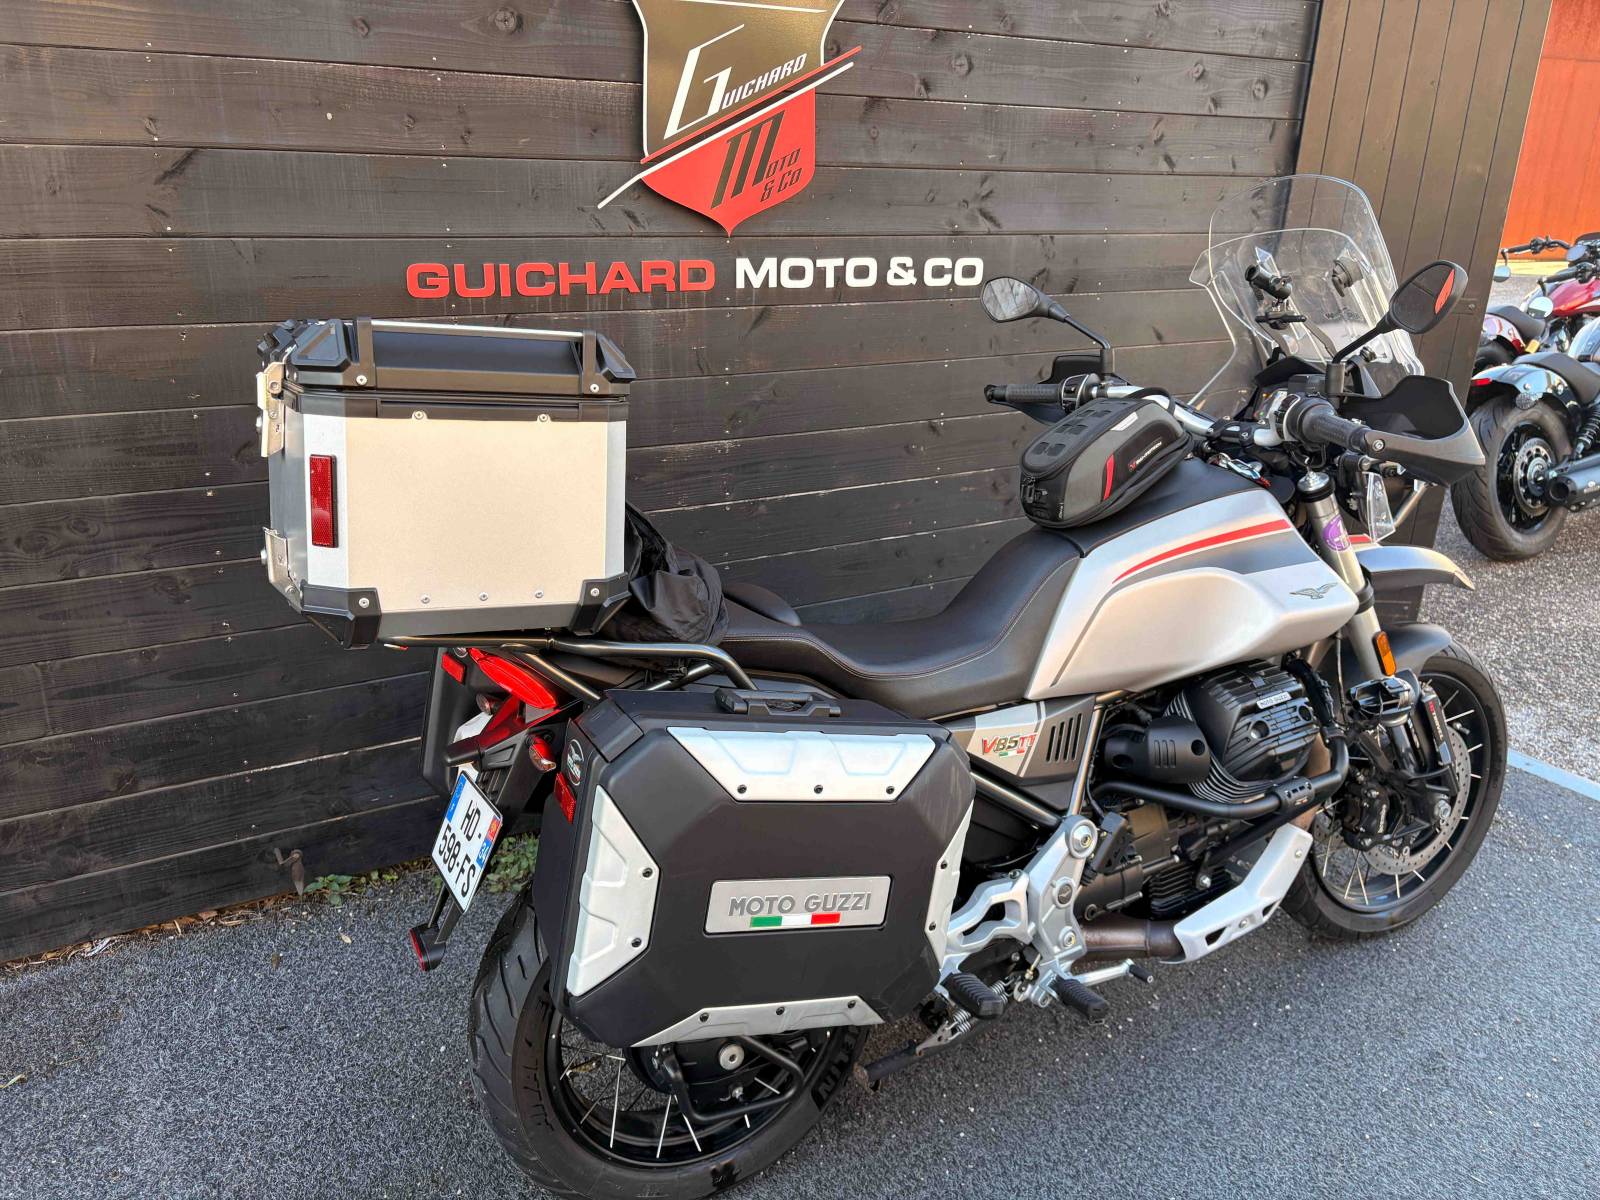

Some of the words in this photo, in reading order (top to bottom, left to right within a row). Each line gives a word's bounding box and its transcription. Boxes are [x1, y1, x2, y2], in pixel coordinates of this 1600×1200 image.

[760, 179, 776, 202] &
[406, 259, 715, 299] GUICHARD
[735, 257, 878, 289] MOTO
[729, 896, 795, 917] MOTO
[804, 893, 872, 912] GUZZI
